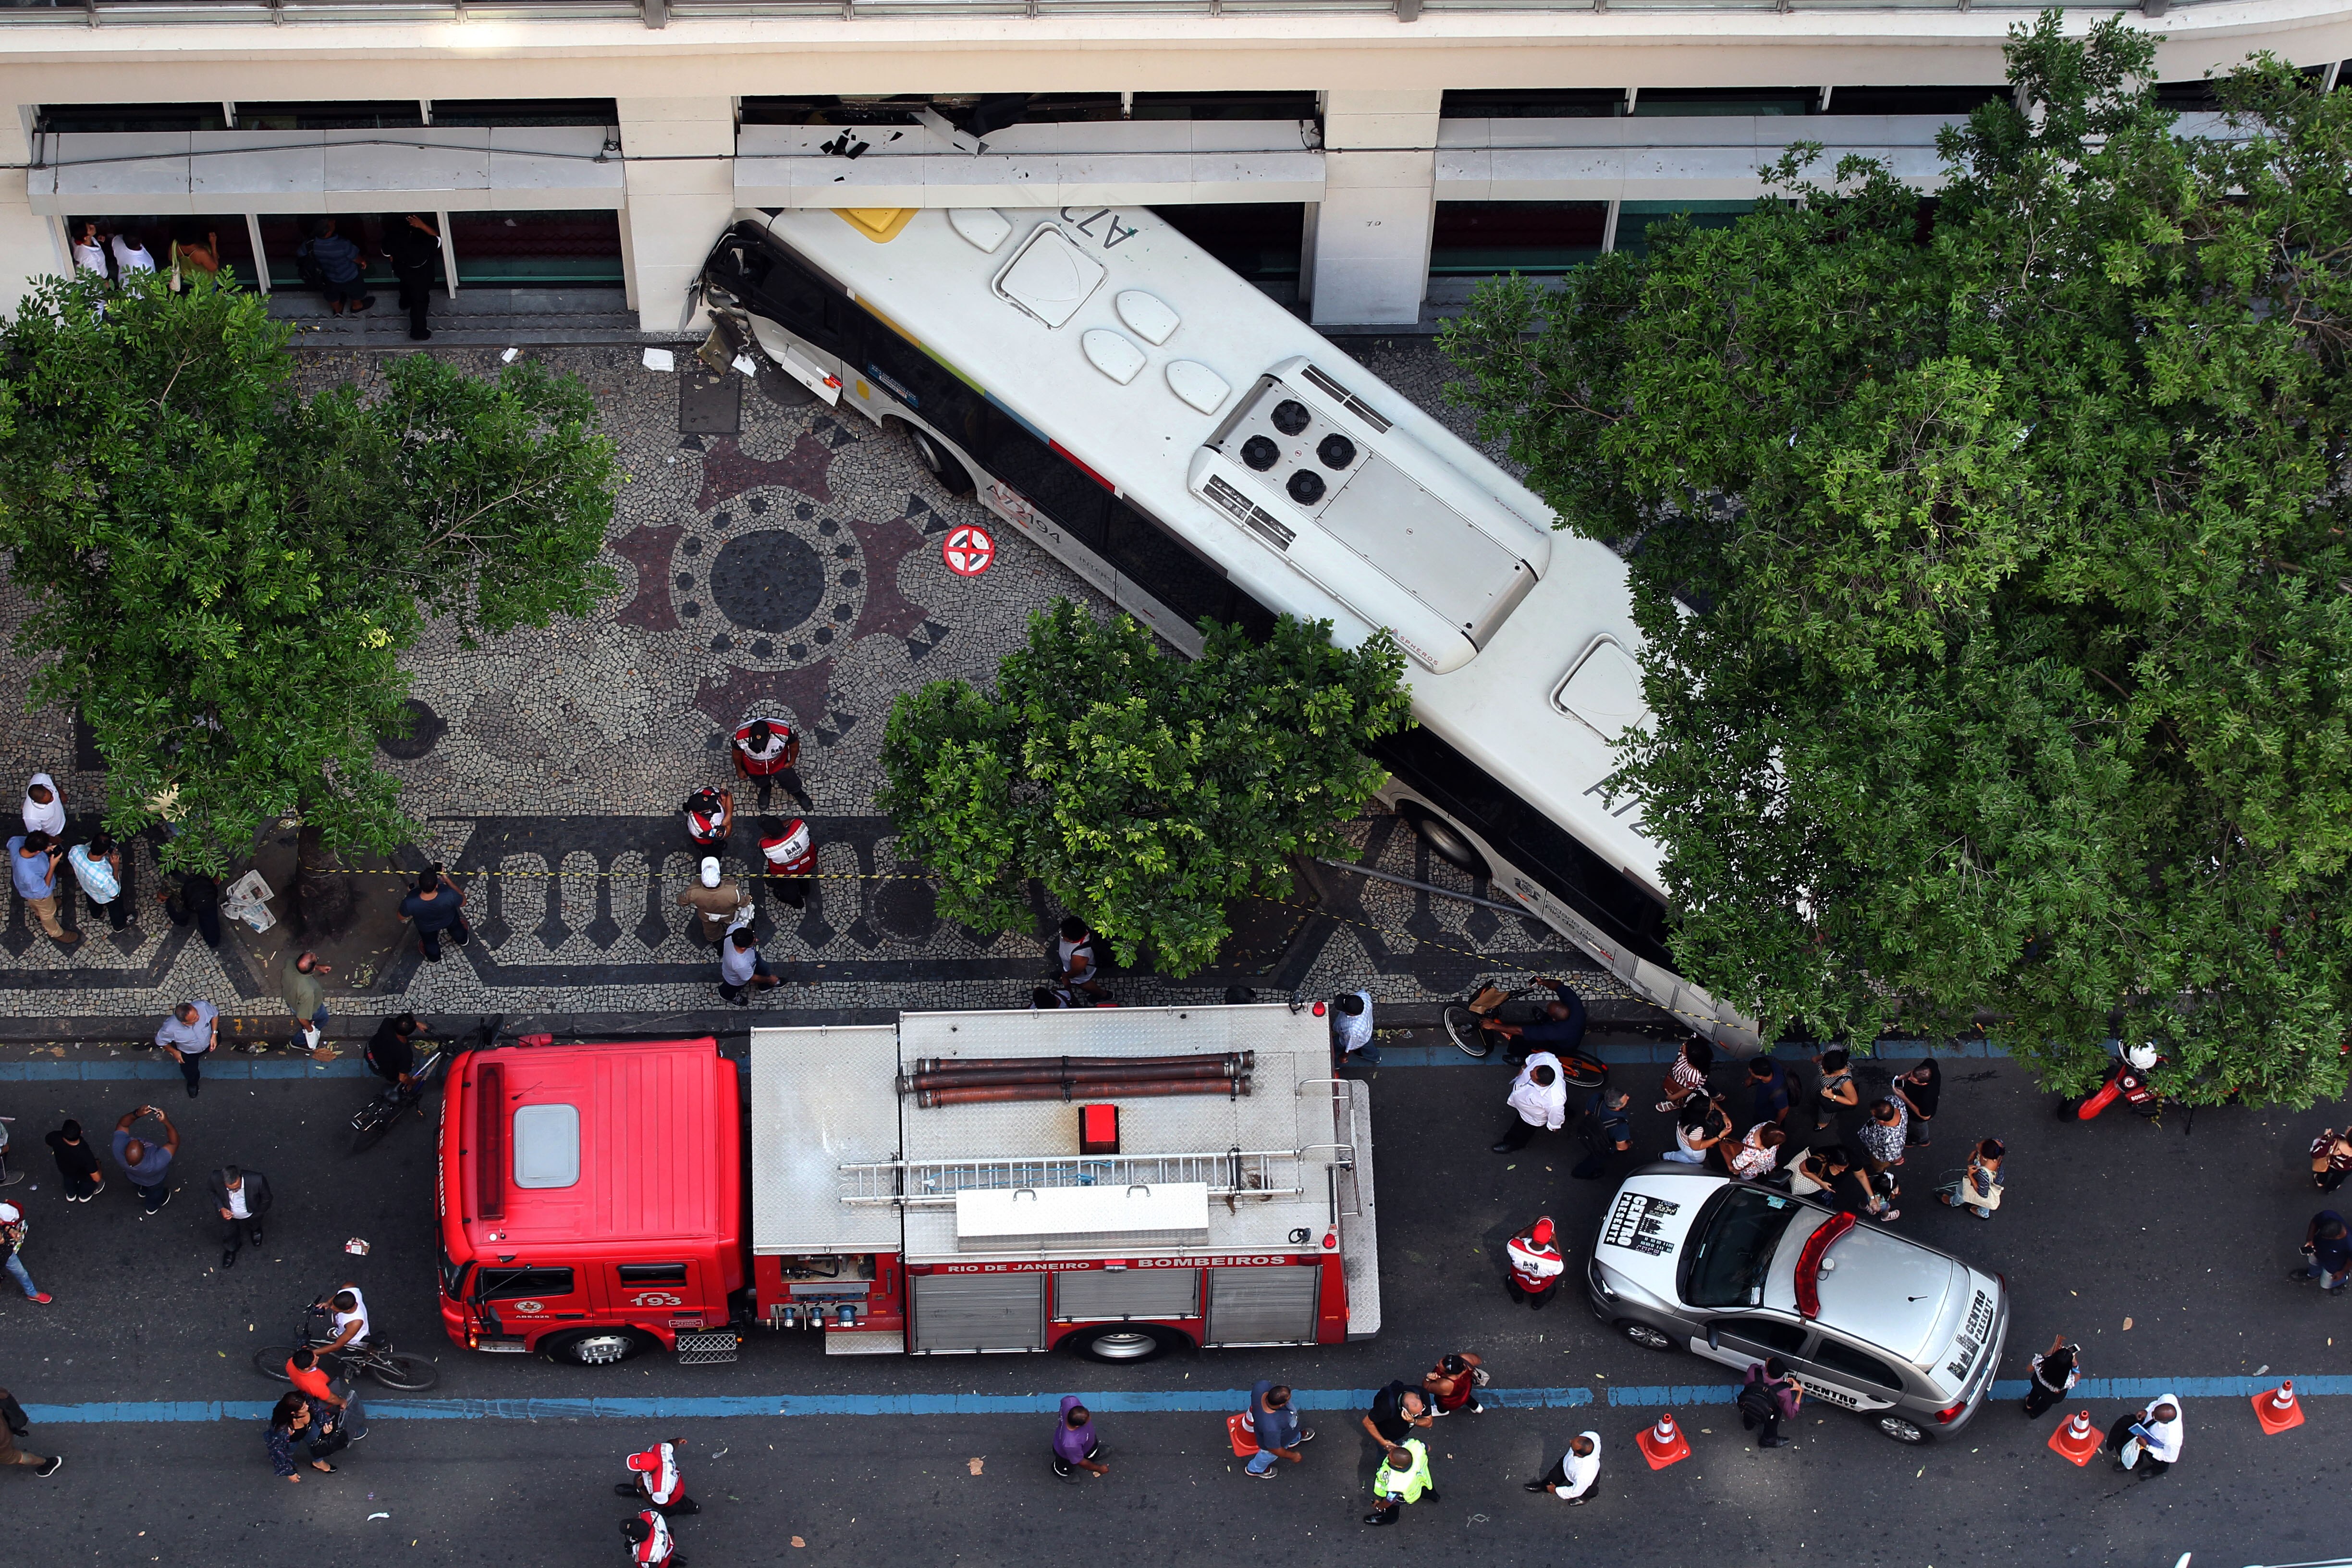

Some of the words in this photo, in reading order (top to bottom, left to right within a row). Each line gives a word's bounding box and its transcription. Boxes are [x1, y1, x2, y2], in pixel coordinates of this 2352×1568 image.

[986, 485, 1061, 543] A72194
[1545, 905, 1560, 918] Rio
[1562, 919, 1575, 930] de
[1577, 931, 1612, 956] Janeiro
[1546, 900, 1580, 928] Cidade
[1582, 928, 1595, 939] do
[439, 1128, 444, 1149] DE
[1606, 1194, 1632, 1243] PRESENTE
[1617, 1196, 1648, 1247] CENTRO
[1013, 1262, 1090, 1271] JANEIRO
[1138, 1256, 1285, 1267] BOMBEIROS
[630, 1297, 682, 1306] 193
[1965, 1289, 1986, 1335] CENTRO
[1974, 1297, 1993, 1341] PRESENTE
[1804, 1382, 1857, 1405] CENTRO
